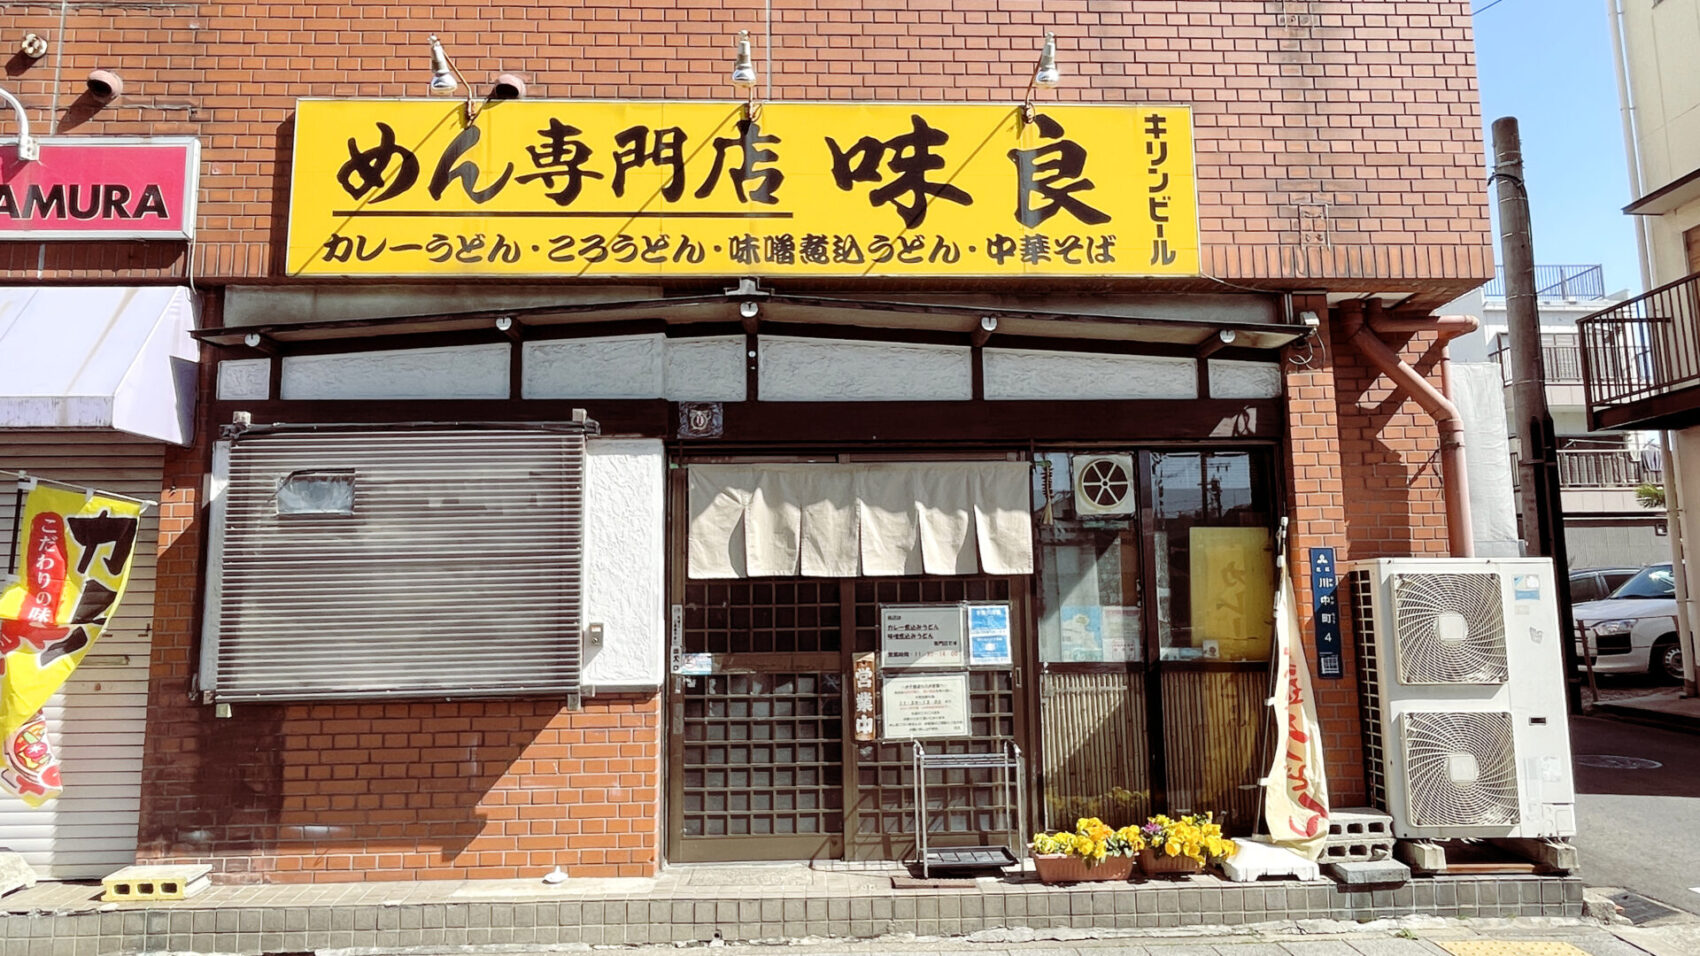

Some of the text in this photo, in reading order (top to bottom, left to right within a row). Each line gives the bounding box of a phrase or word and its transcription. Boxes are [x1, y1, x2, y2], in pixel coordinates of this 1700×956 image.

[335, 114, 1113, 230] めん専門店 味良
[1144, 113, 1177, 266] キリンビール
[28, 518, 57, 623] こだわりの味
[855, 667, 873, 735] 営業中
